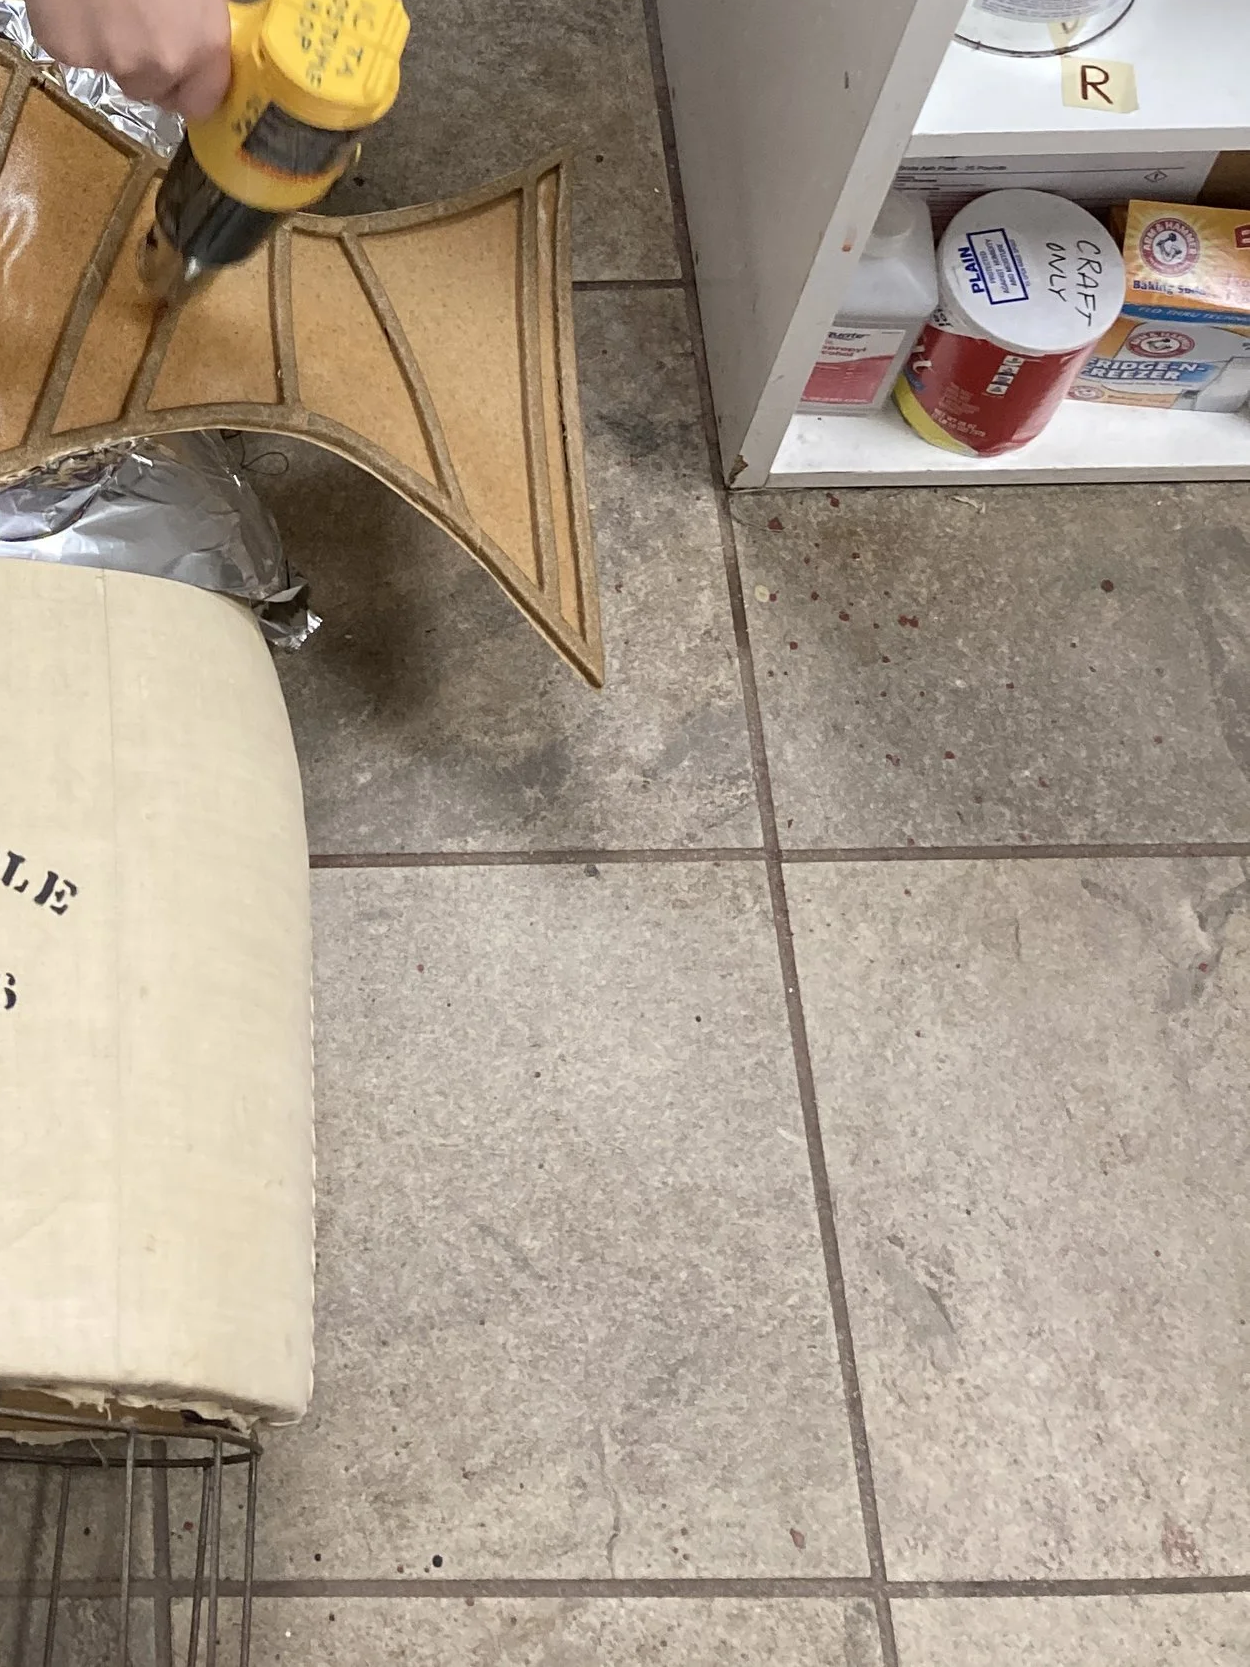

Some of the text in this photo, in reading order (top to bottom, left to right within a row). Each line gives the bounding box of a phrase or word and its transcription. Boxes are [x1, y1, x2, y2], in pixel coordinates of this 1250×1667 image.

[1081, 64, 1114, 105] R
[958, 247, 985, 294] PLAIN
[980, 250, 996, 284] PROTECTED
[985, 238, 1010, 294] AGAINST HUMIDITY
[996, 244, 1012, 273] MOISTURE
[1046, 242, 1067, 302] ONLY
[1075, 240, 1103, 327] CRAFT
[1133, 279, 1175, 295] Baking
